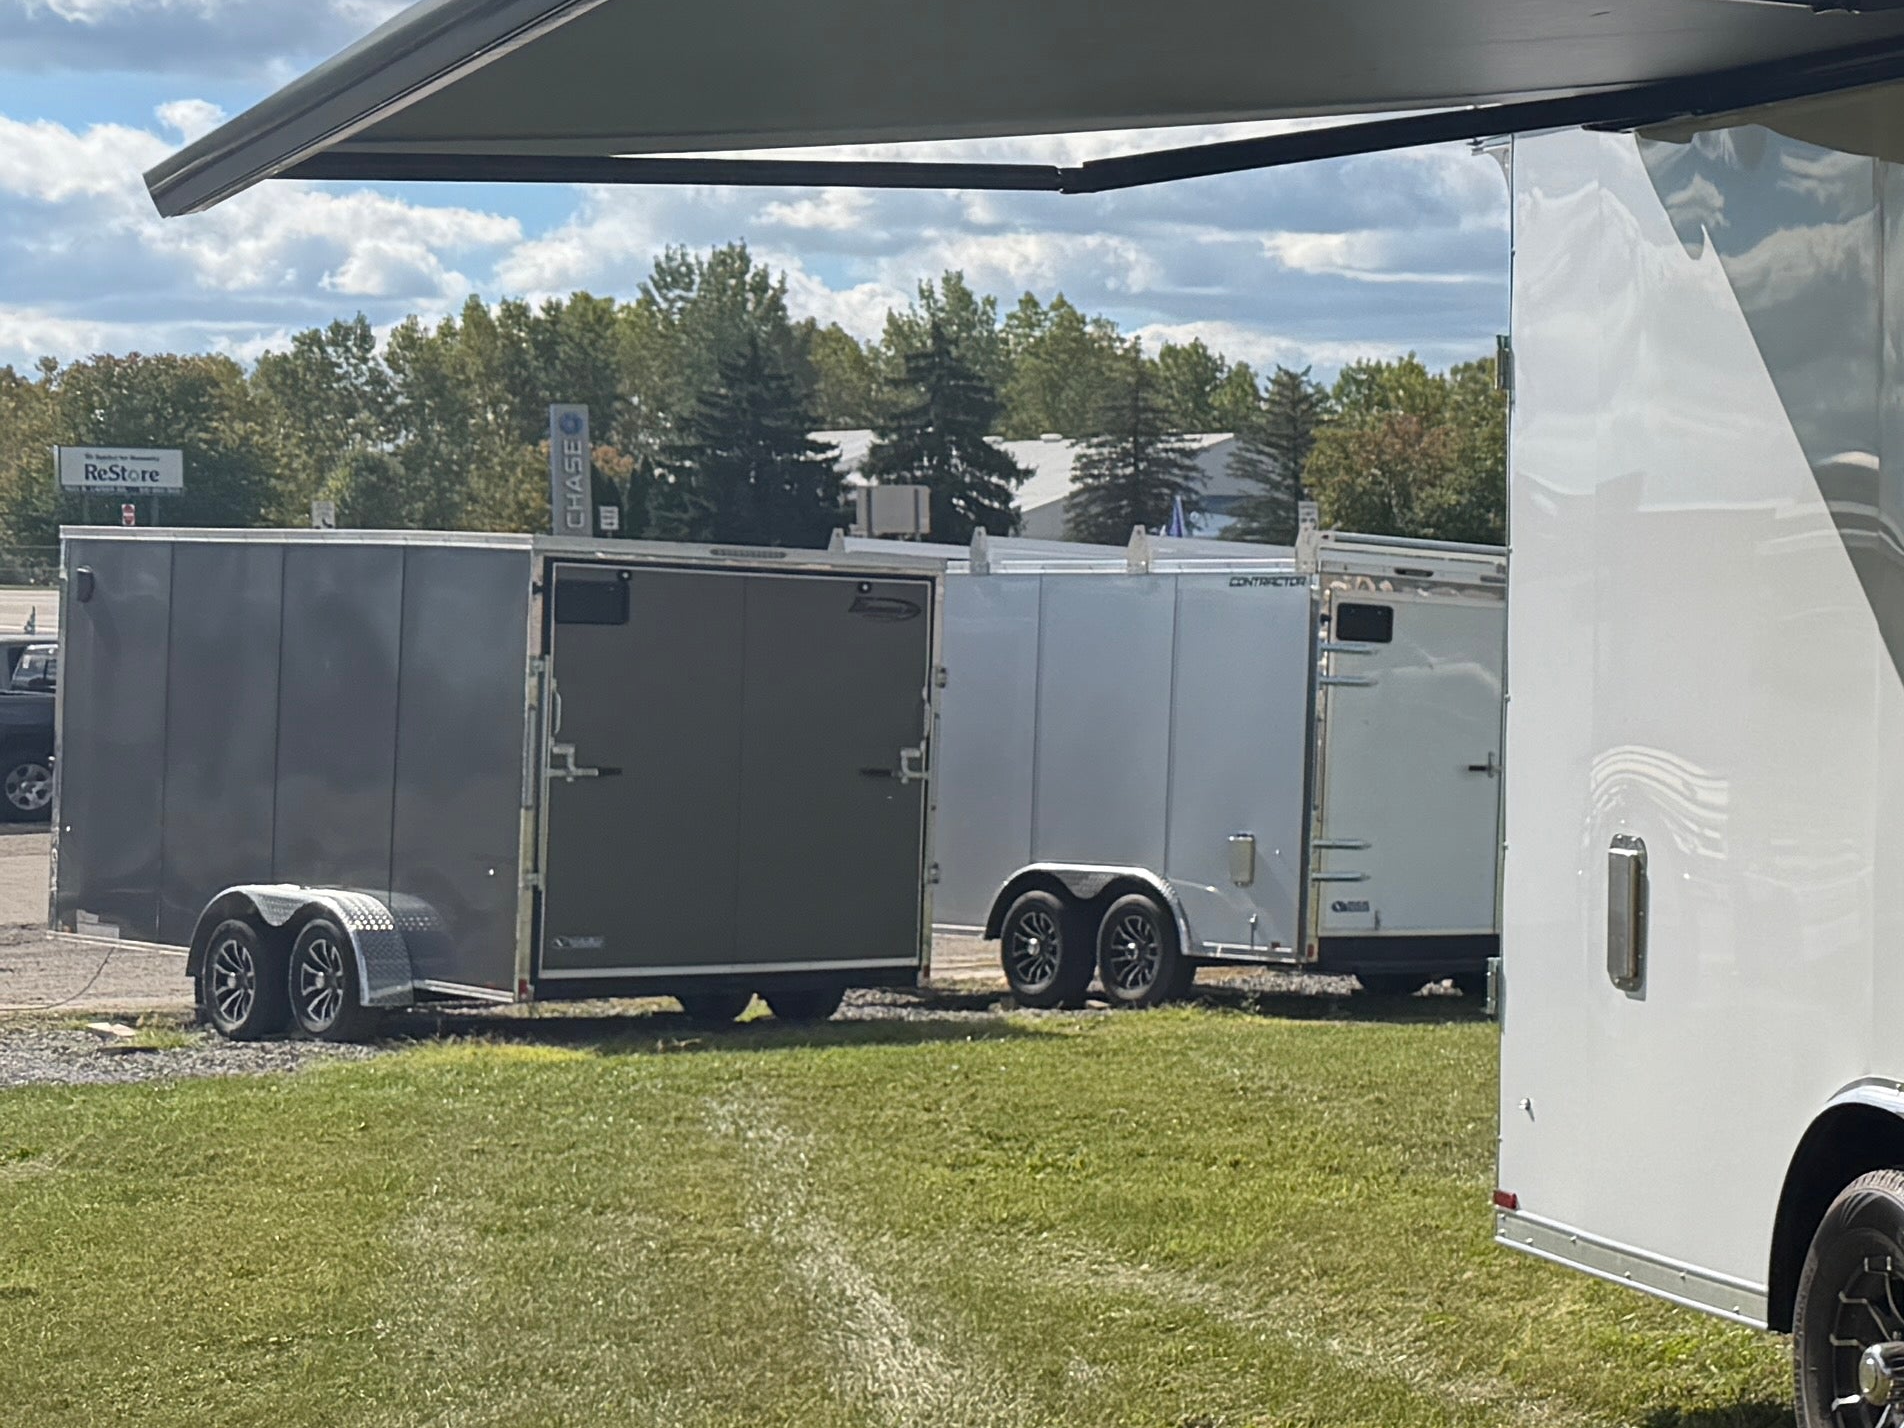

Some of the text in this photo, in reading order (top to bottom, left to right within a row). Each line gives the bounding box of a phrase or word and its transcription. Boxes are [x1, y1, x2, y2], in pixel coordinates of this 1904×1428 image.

[84, 463, 160, 483] ReStore
[563, 439, 585, 528] CHASE
[1229, 575, 1307, 588] CONTRACTOR
